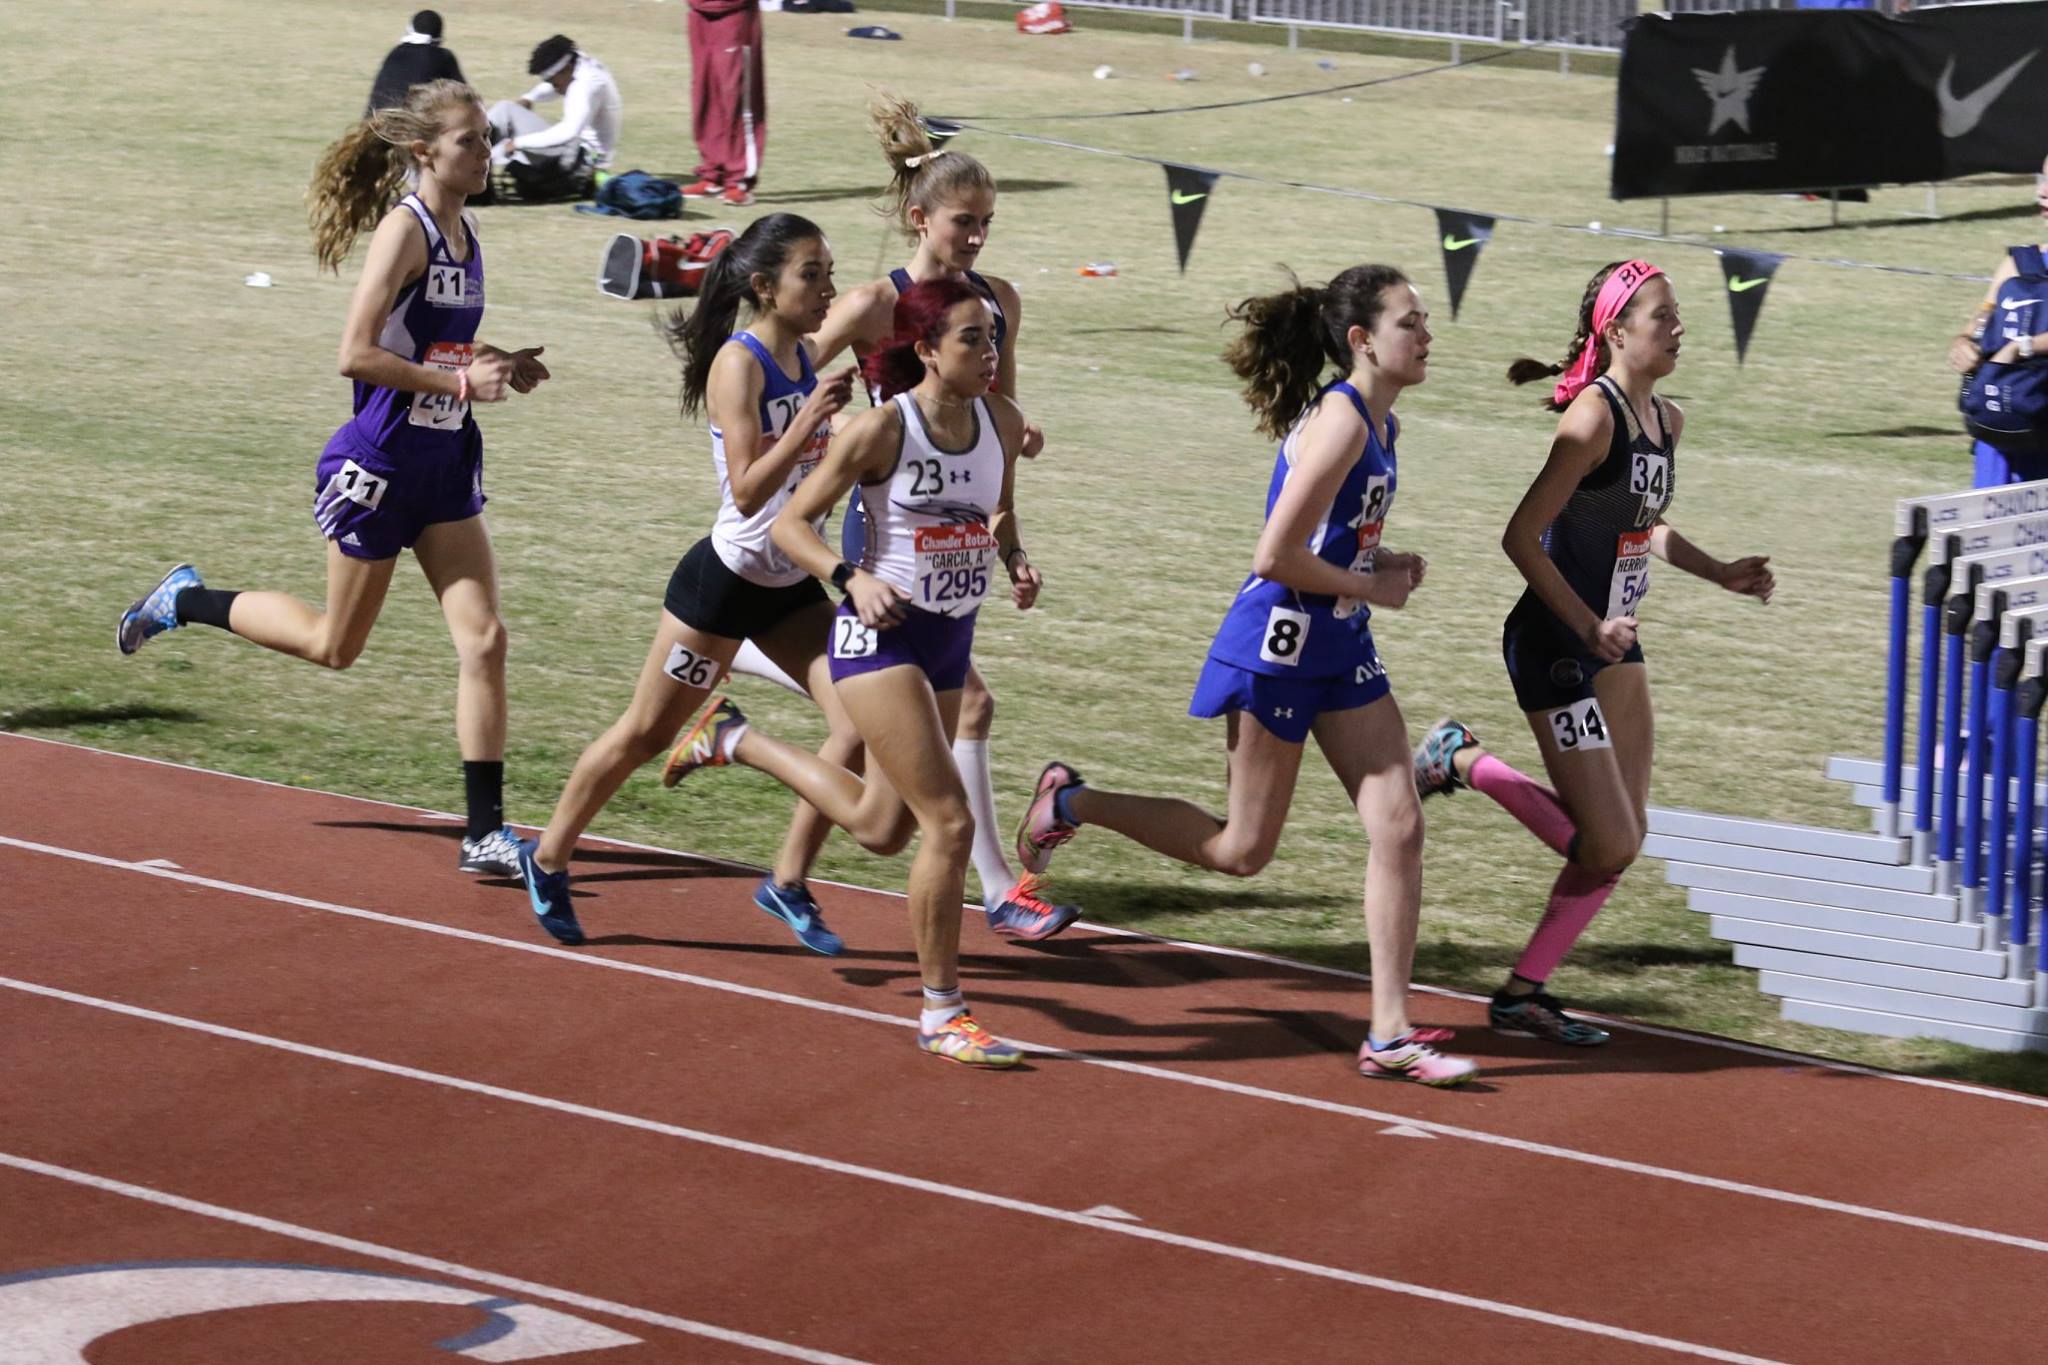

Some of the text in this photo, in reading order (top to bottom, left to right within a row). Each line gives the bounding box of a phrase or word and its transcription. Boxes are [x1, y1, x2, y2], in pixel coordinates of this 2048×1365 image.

[432, 269, 461, 297] 11
[345, 470, 380, 501] 11
[907, 458, 944, 497] 23
[1634, 455, 1665, 503] 34
[1365, 485, 1385, 519] 8
[921, 535, 963, 551] Chandler
[919, 565, 988, 603] 1295
[840, 619, 868, 656] 23
[1268, 618, 1301, 657] 8
[671, 650, 712, 685] 26
[1555, 704, 1604, 748] 34
